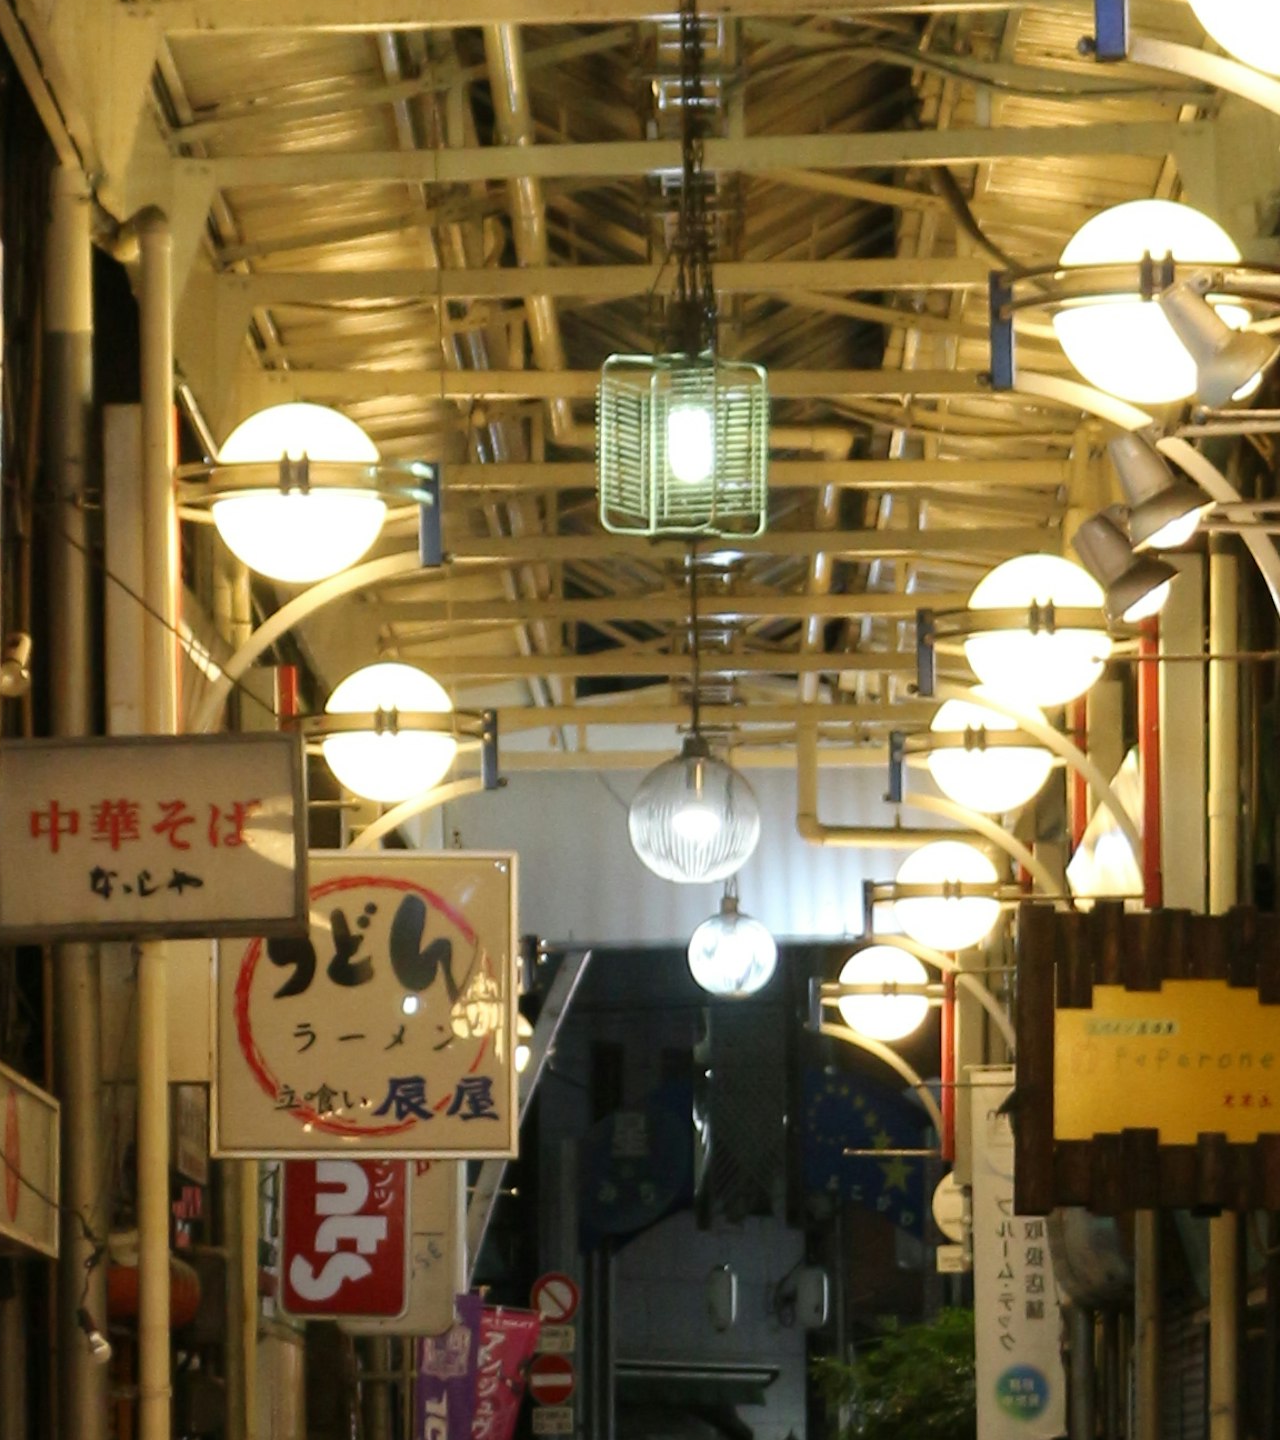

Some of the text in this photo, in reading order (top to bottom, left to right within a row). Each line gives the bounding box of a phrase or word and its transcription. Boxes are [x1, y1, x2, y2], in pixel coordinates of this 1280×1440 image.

[28, 799, 262, 854] 中華そば
[293, 1022, 456, 1053] ラーメン
[274, 1074, 500, 1121] 立喰い 辰屋
